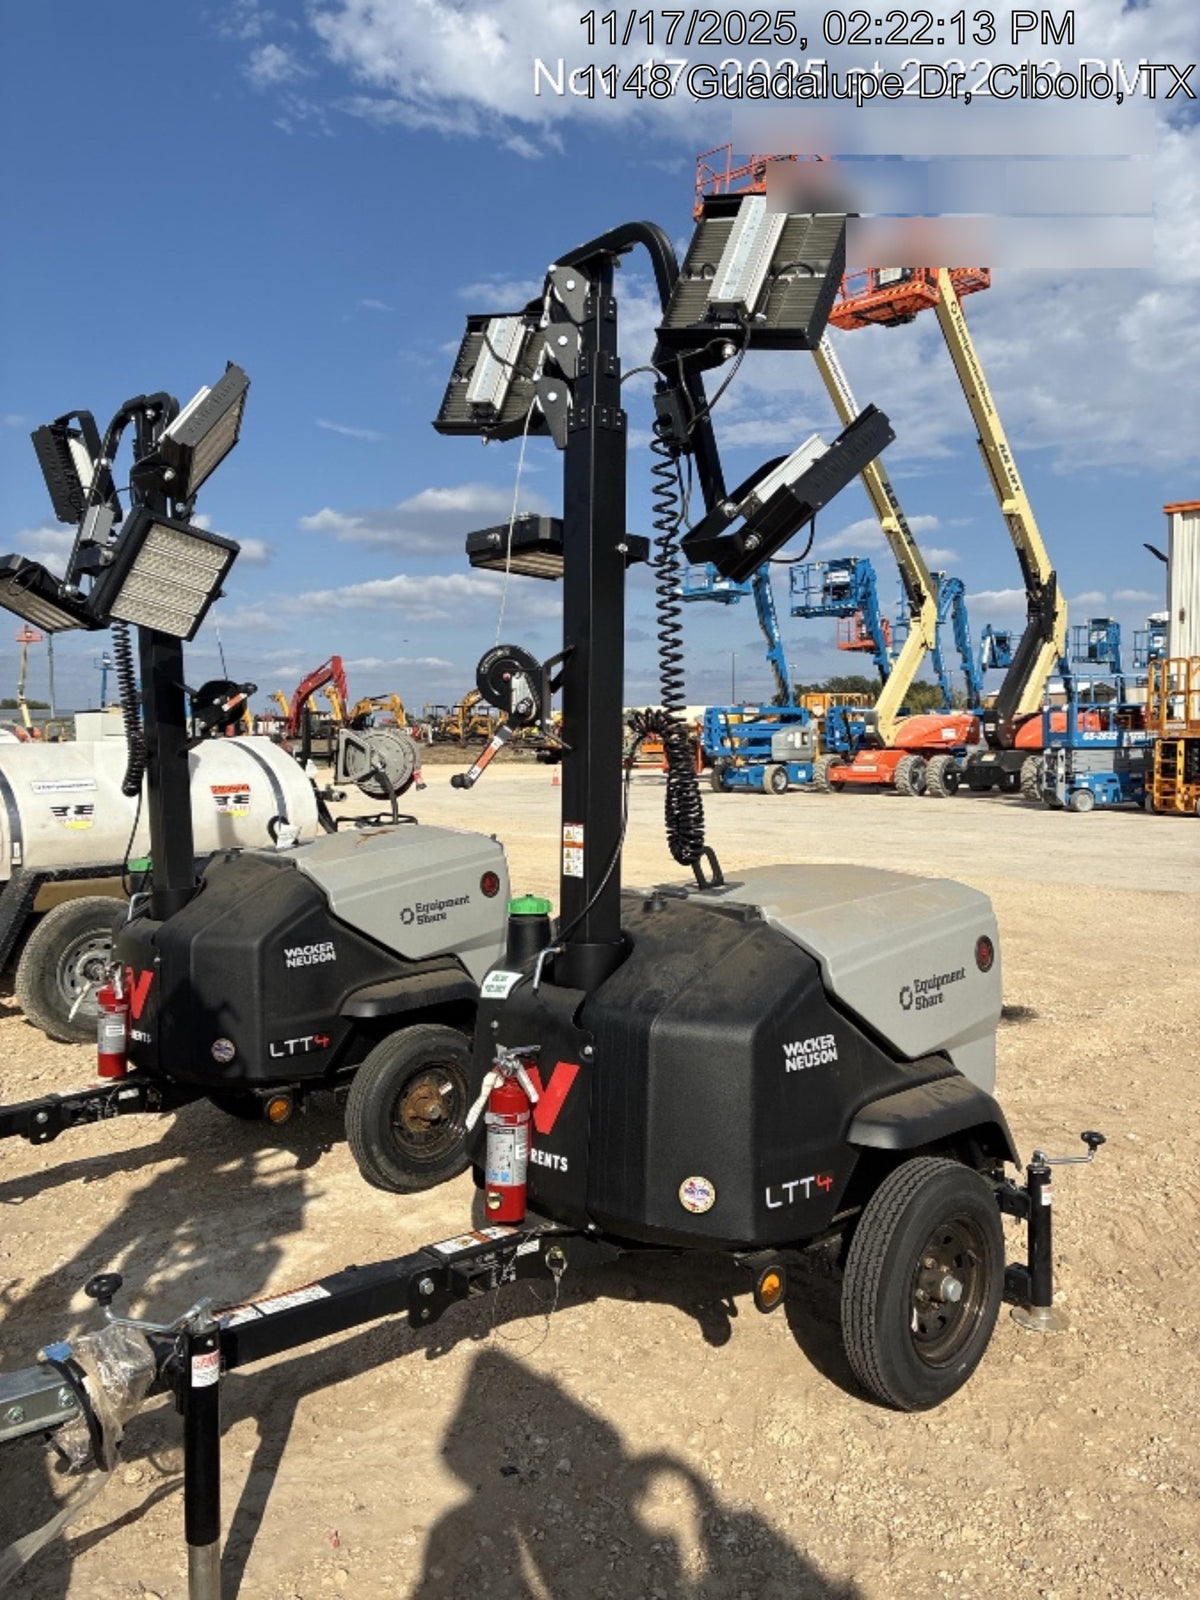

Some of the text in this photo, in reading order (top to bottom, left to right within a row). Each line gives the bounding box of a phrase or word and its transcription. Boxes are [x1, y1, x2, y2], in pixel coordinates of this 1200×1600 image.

[415, 893, 470, 914] Equipment
[416, 912, 447, 925] Share
[284, 941, 335, 958] WACKER
[286, 950, 337, 968] NEUSON
[913, 966, 966, 994] Equipment
[915, 992, 944, 1011] Share
[269, 1034, 330, 1057] LTT4
[782, 1034, 836, 1058] WACKER
[785, 1046, 838, 1072] NEUSON
[765, 1174, 833, 1209] LTT4
